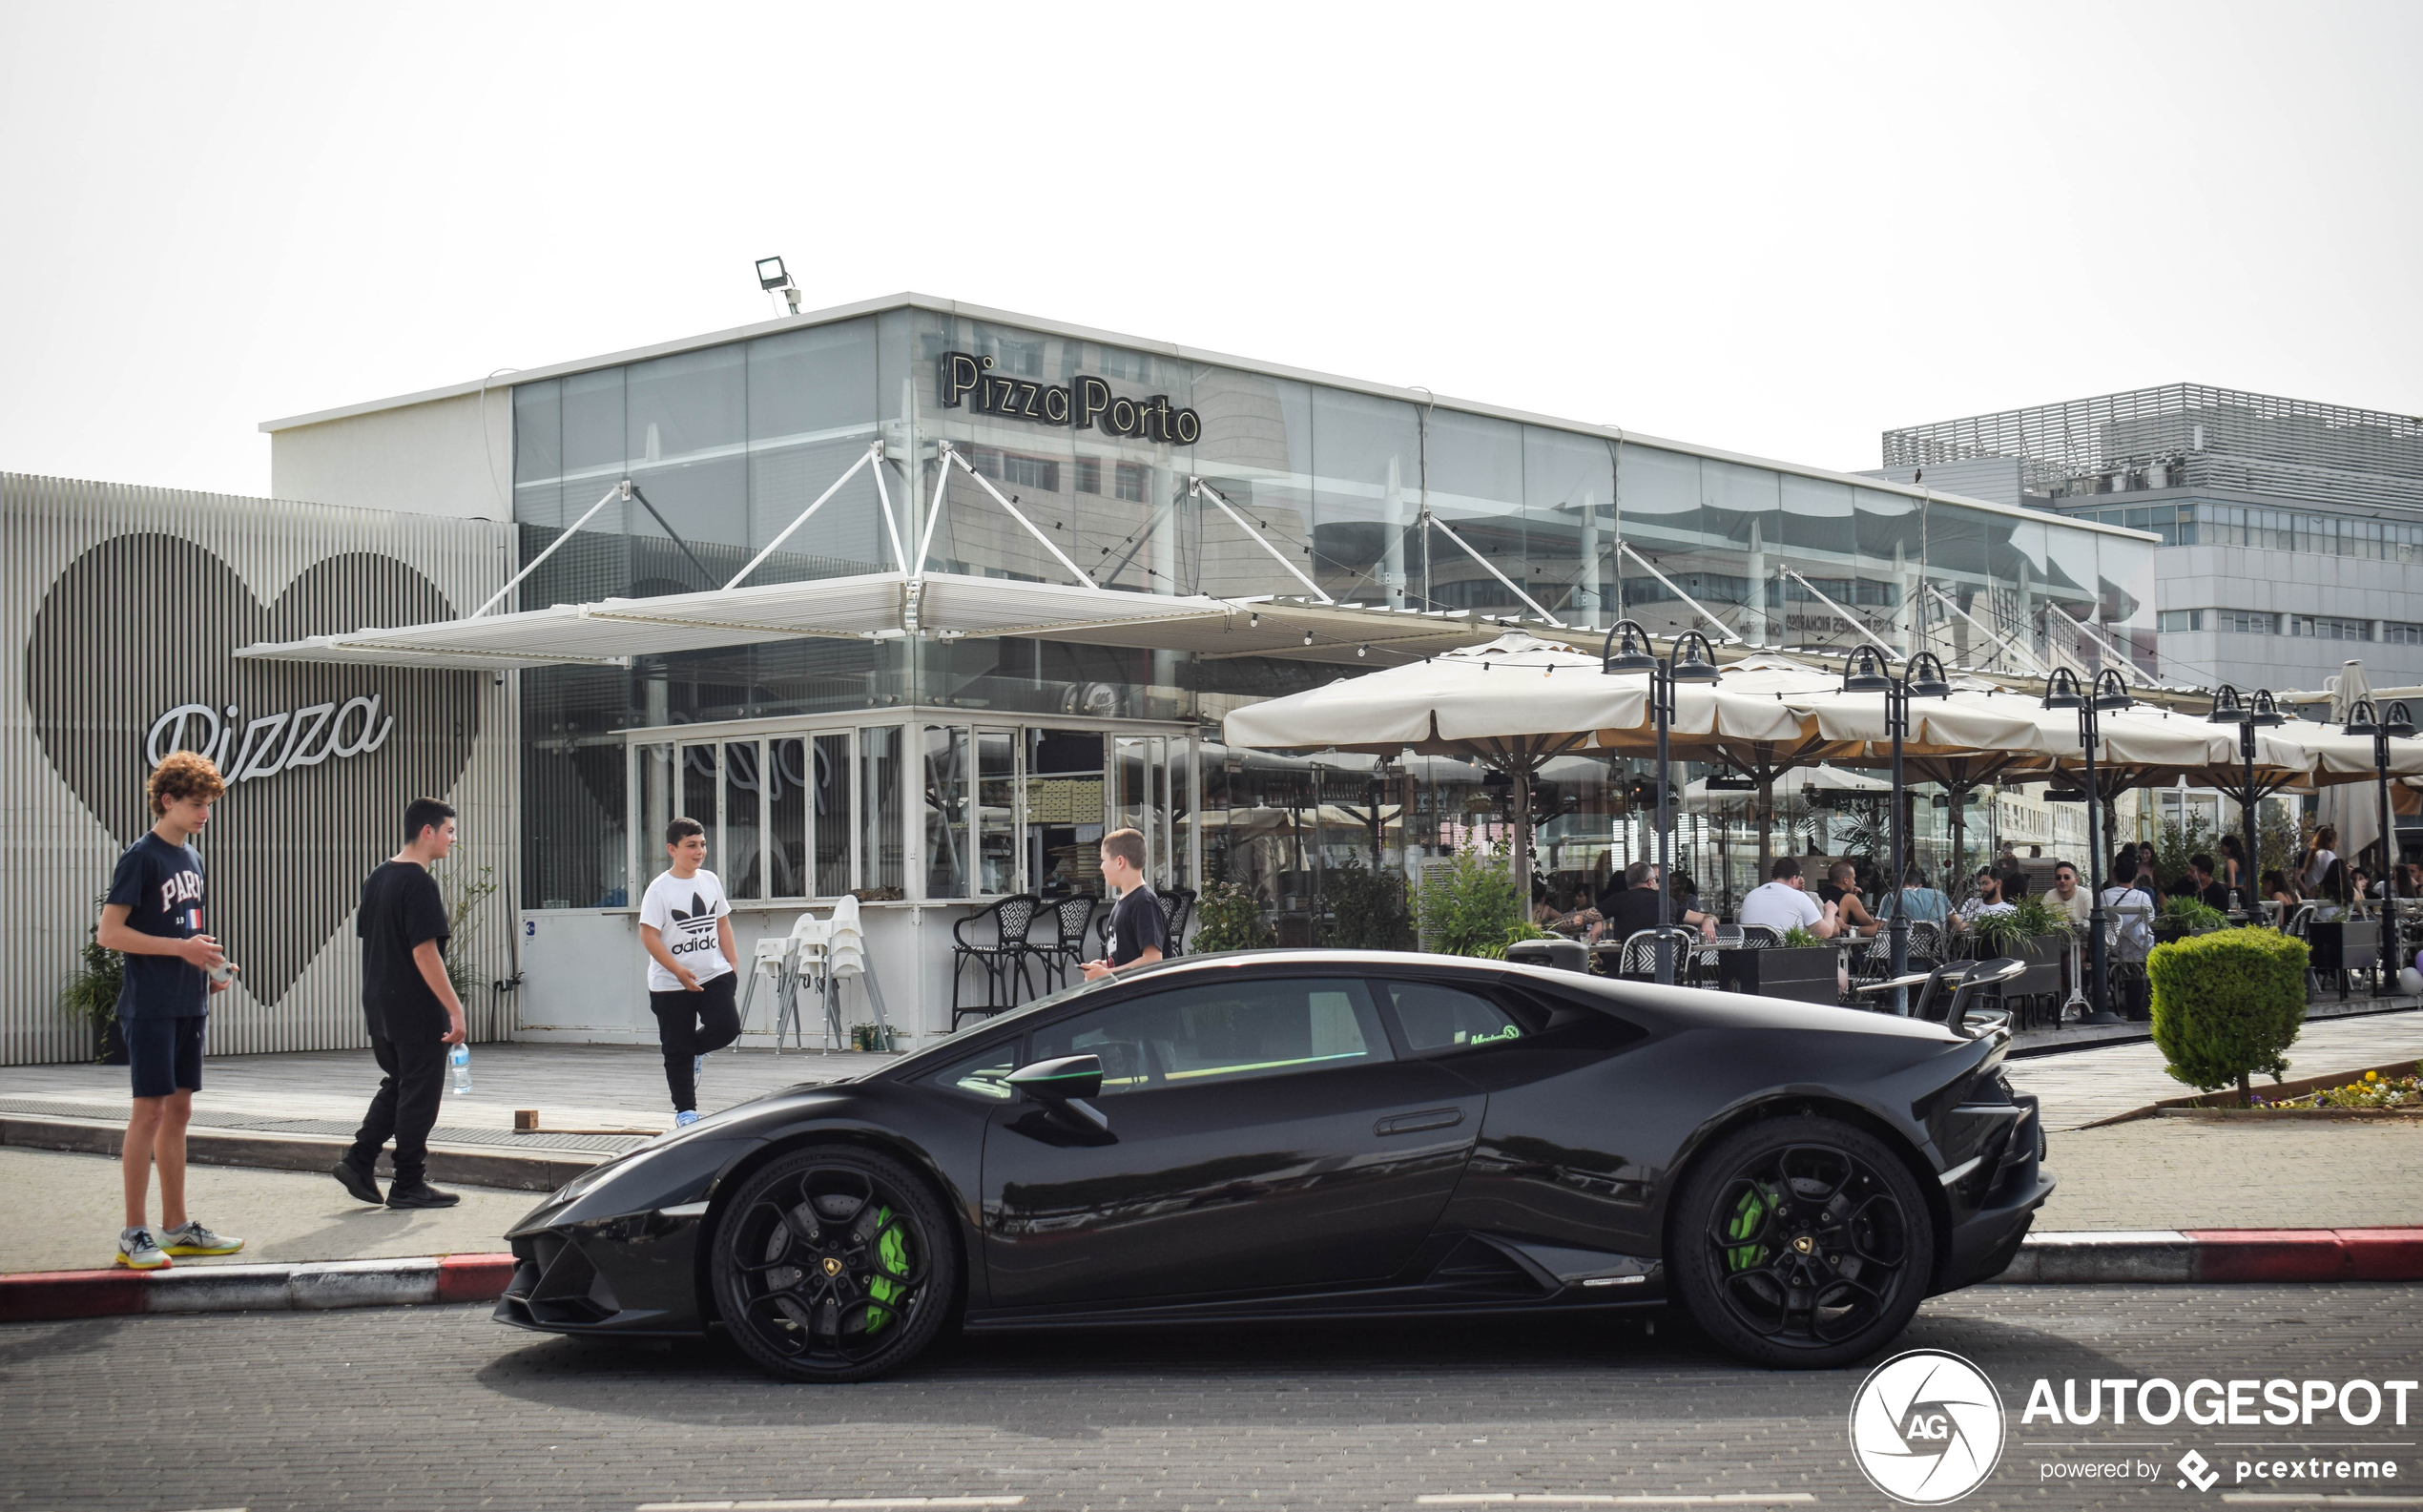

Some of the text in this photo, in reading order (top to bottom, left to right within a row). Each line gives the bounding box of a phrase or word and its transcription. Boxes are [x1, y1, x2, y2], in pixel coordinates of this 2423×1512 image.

[942, 350, 1202, 446] Pizza Porto
[146, 693, 394, 788] Pizza
[161, 870, 203, 913] PARI
